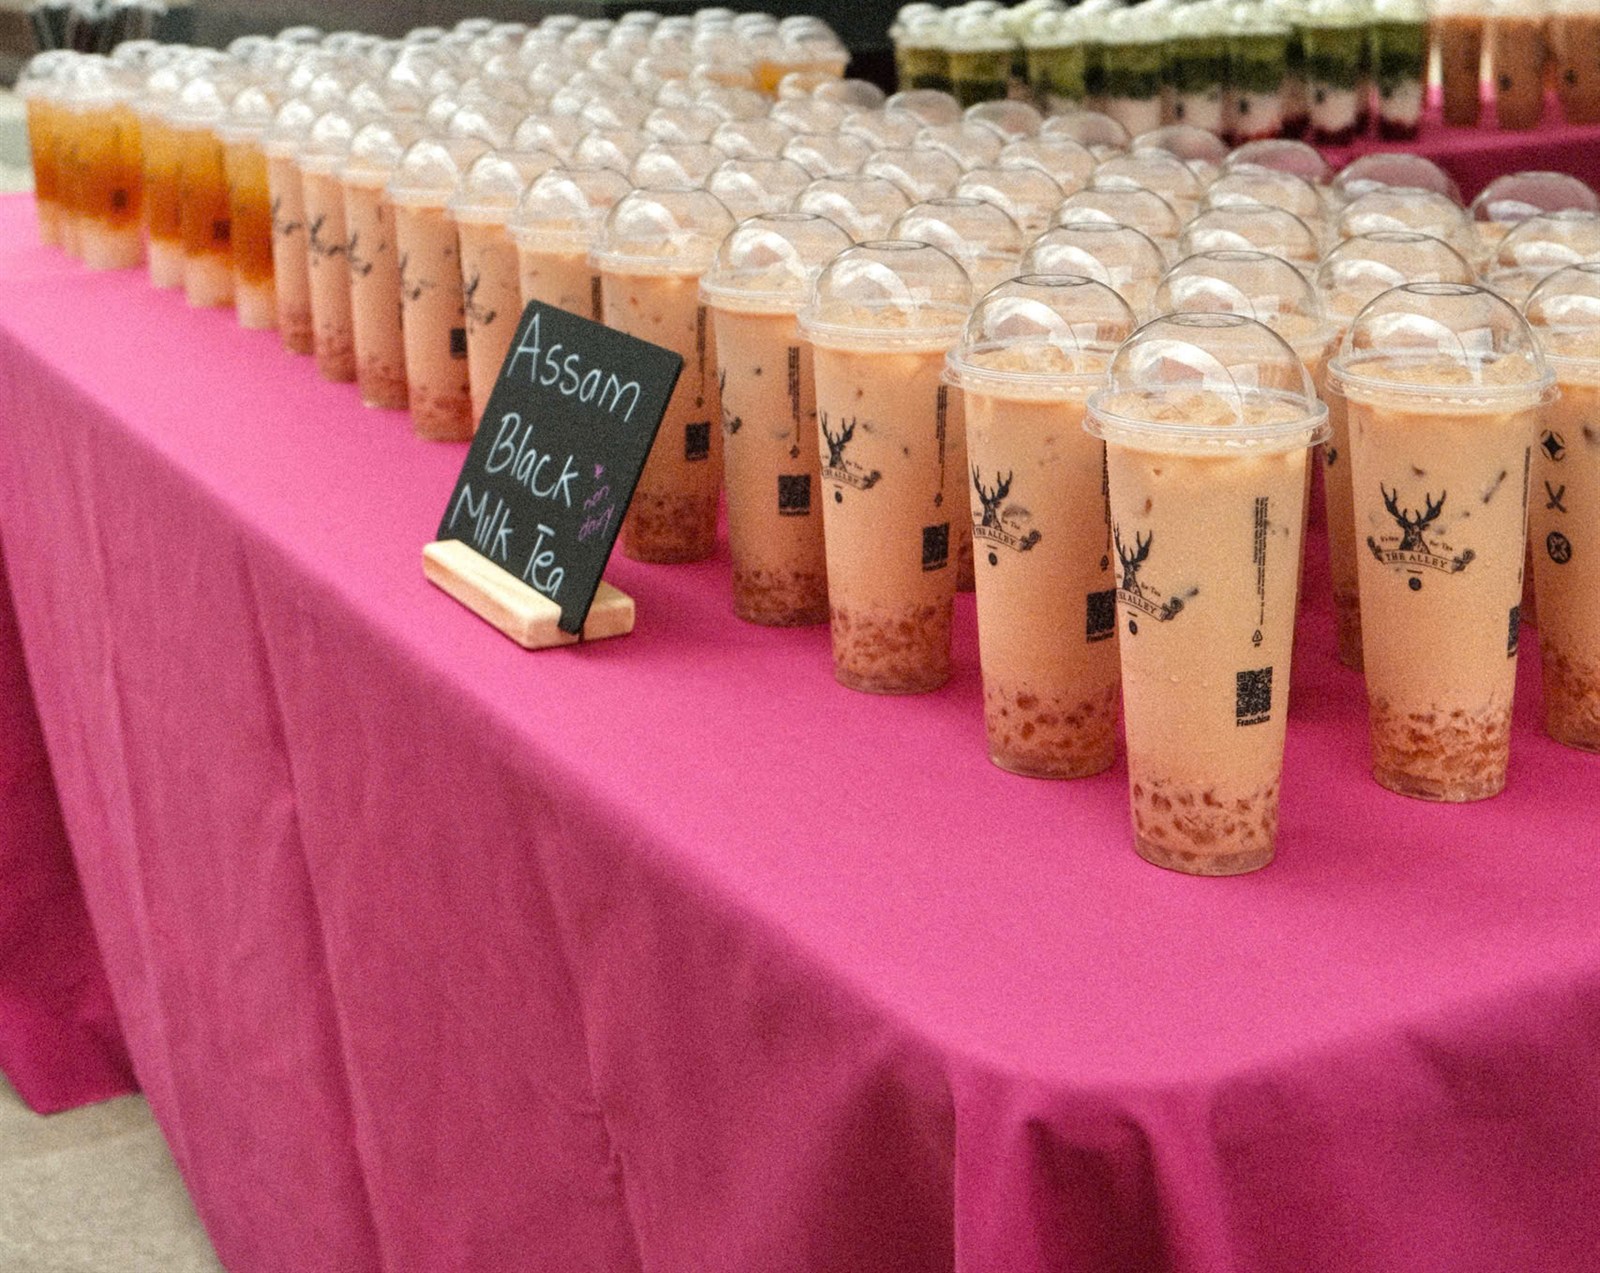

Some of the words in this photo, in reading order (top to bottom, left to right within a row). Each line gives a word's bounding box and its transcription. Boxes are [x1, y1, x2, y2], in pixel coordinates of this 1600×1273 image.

[506, 313, 641, 423] Assam
[485, 412, 579, 508] Black
[450, 483, 514, 561] Milk
[523, 524, 565, 598] Tea
[987, 529, 1017, 546] ALLEY
[1385, 551, 1406, 562] THE
[1408, 553, 1449, 569] ALLEY
[1128, 594, 1158, 614] ALLEY
